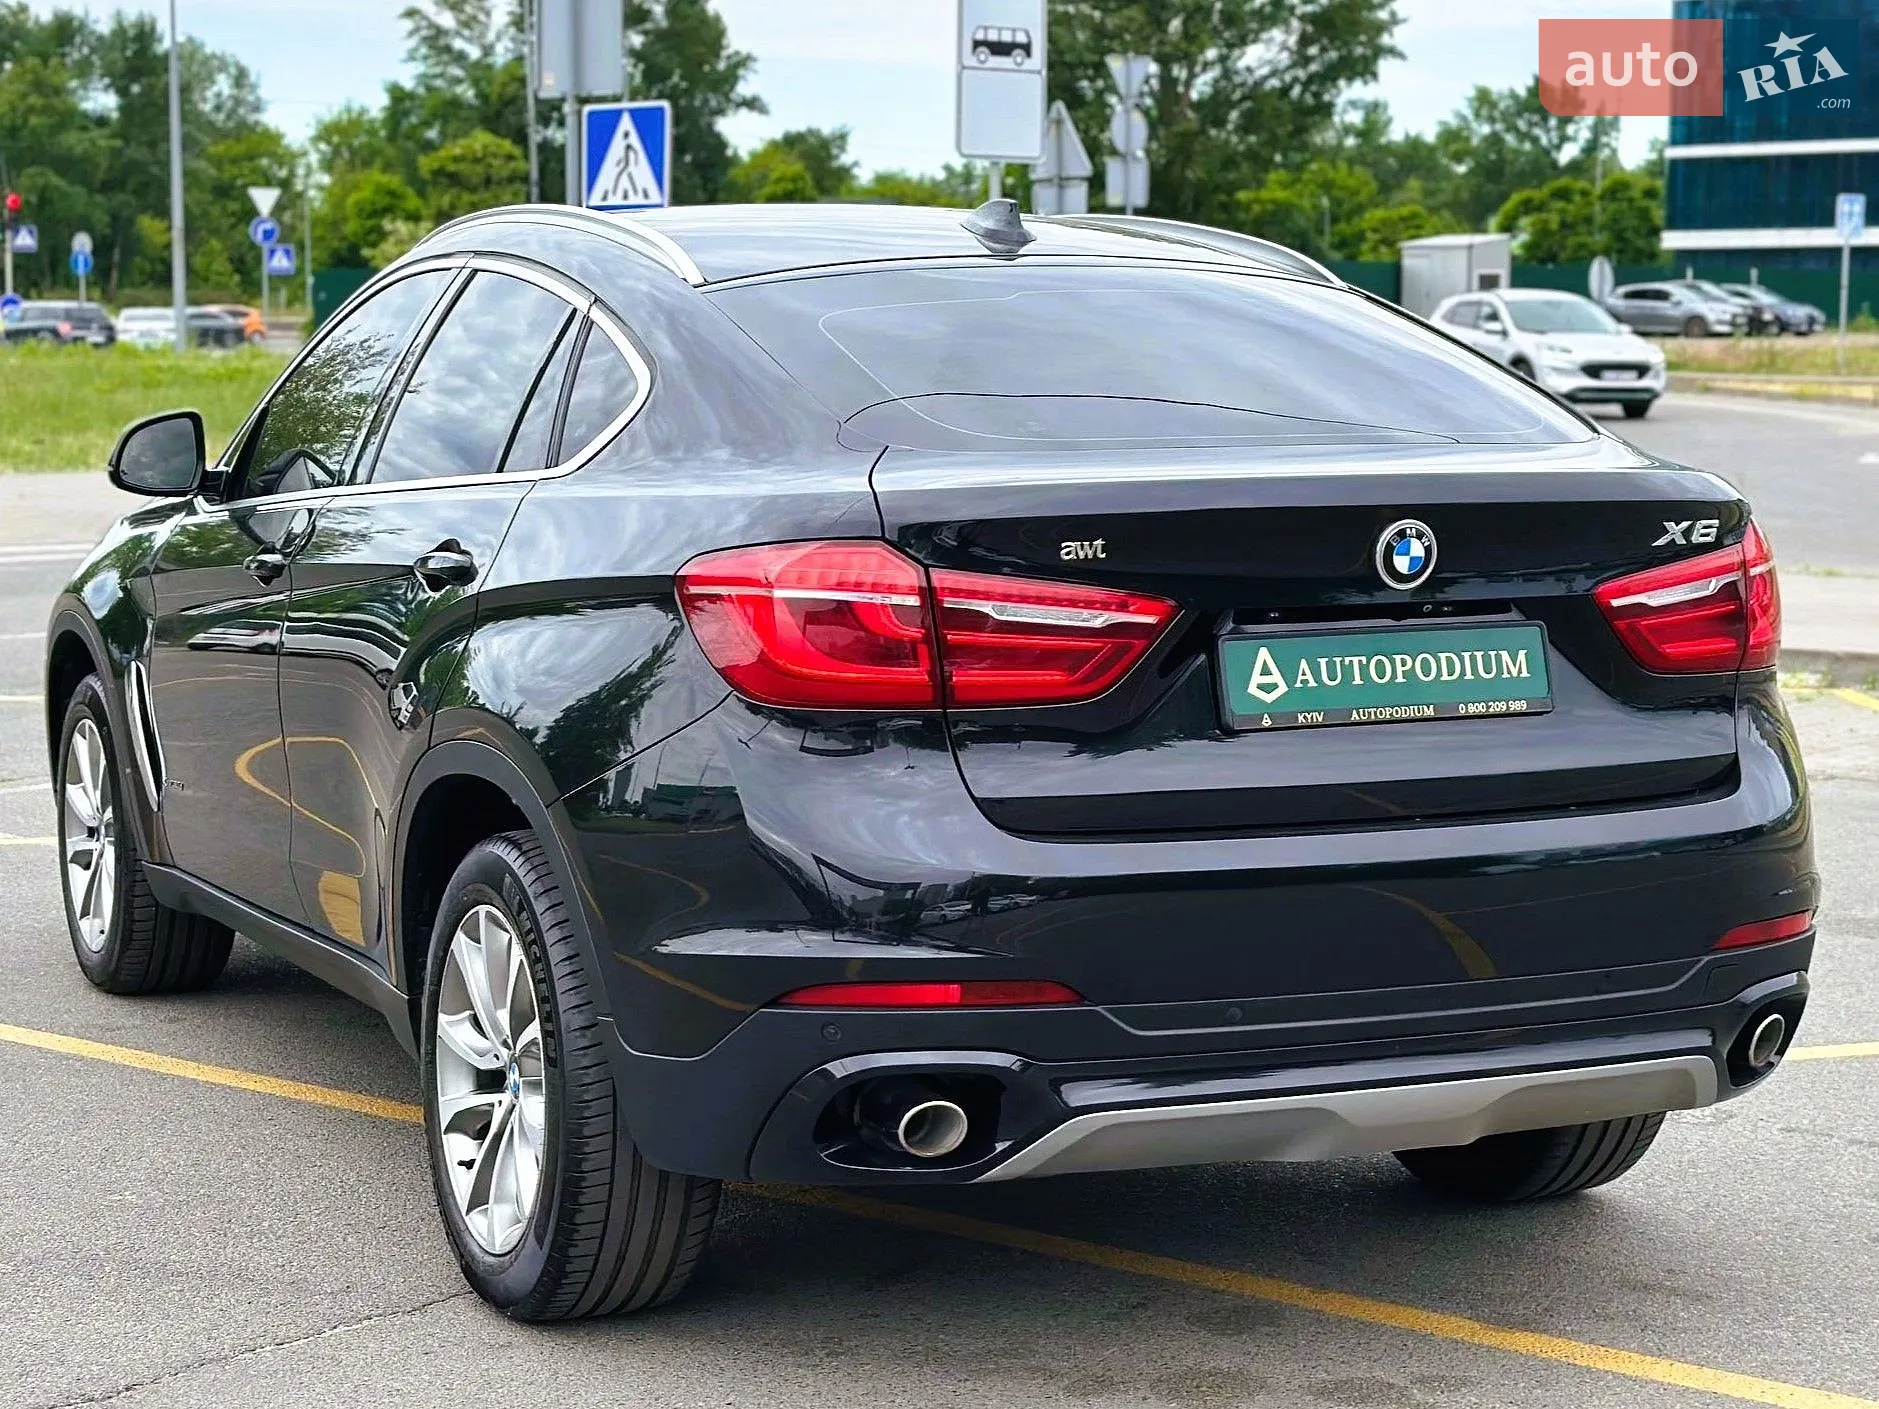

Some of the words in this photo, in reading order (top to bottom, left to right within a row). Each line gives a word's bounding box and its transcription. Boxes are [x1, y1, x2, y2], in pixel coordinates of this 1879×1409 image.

[1389, 527, 1431, 547] BMW
[1651, 519, 1720, 546] X6
[1060, 538, 1106, 560] awt
[1294, 649, 1531, 688] AUTOPODIUM
[1297, 711, 1324, 723] KYIV
[1350, 704, 1435, 720] AUTOPODIUM
[1458, 703, 1466, 714] 0
[1468, 702, 1487, 713] 800
[1488, 701, 1507, 712] 209
[1508, 699, 1527, 711] 989
